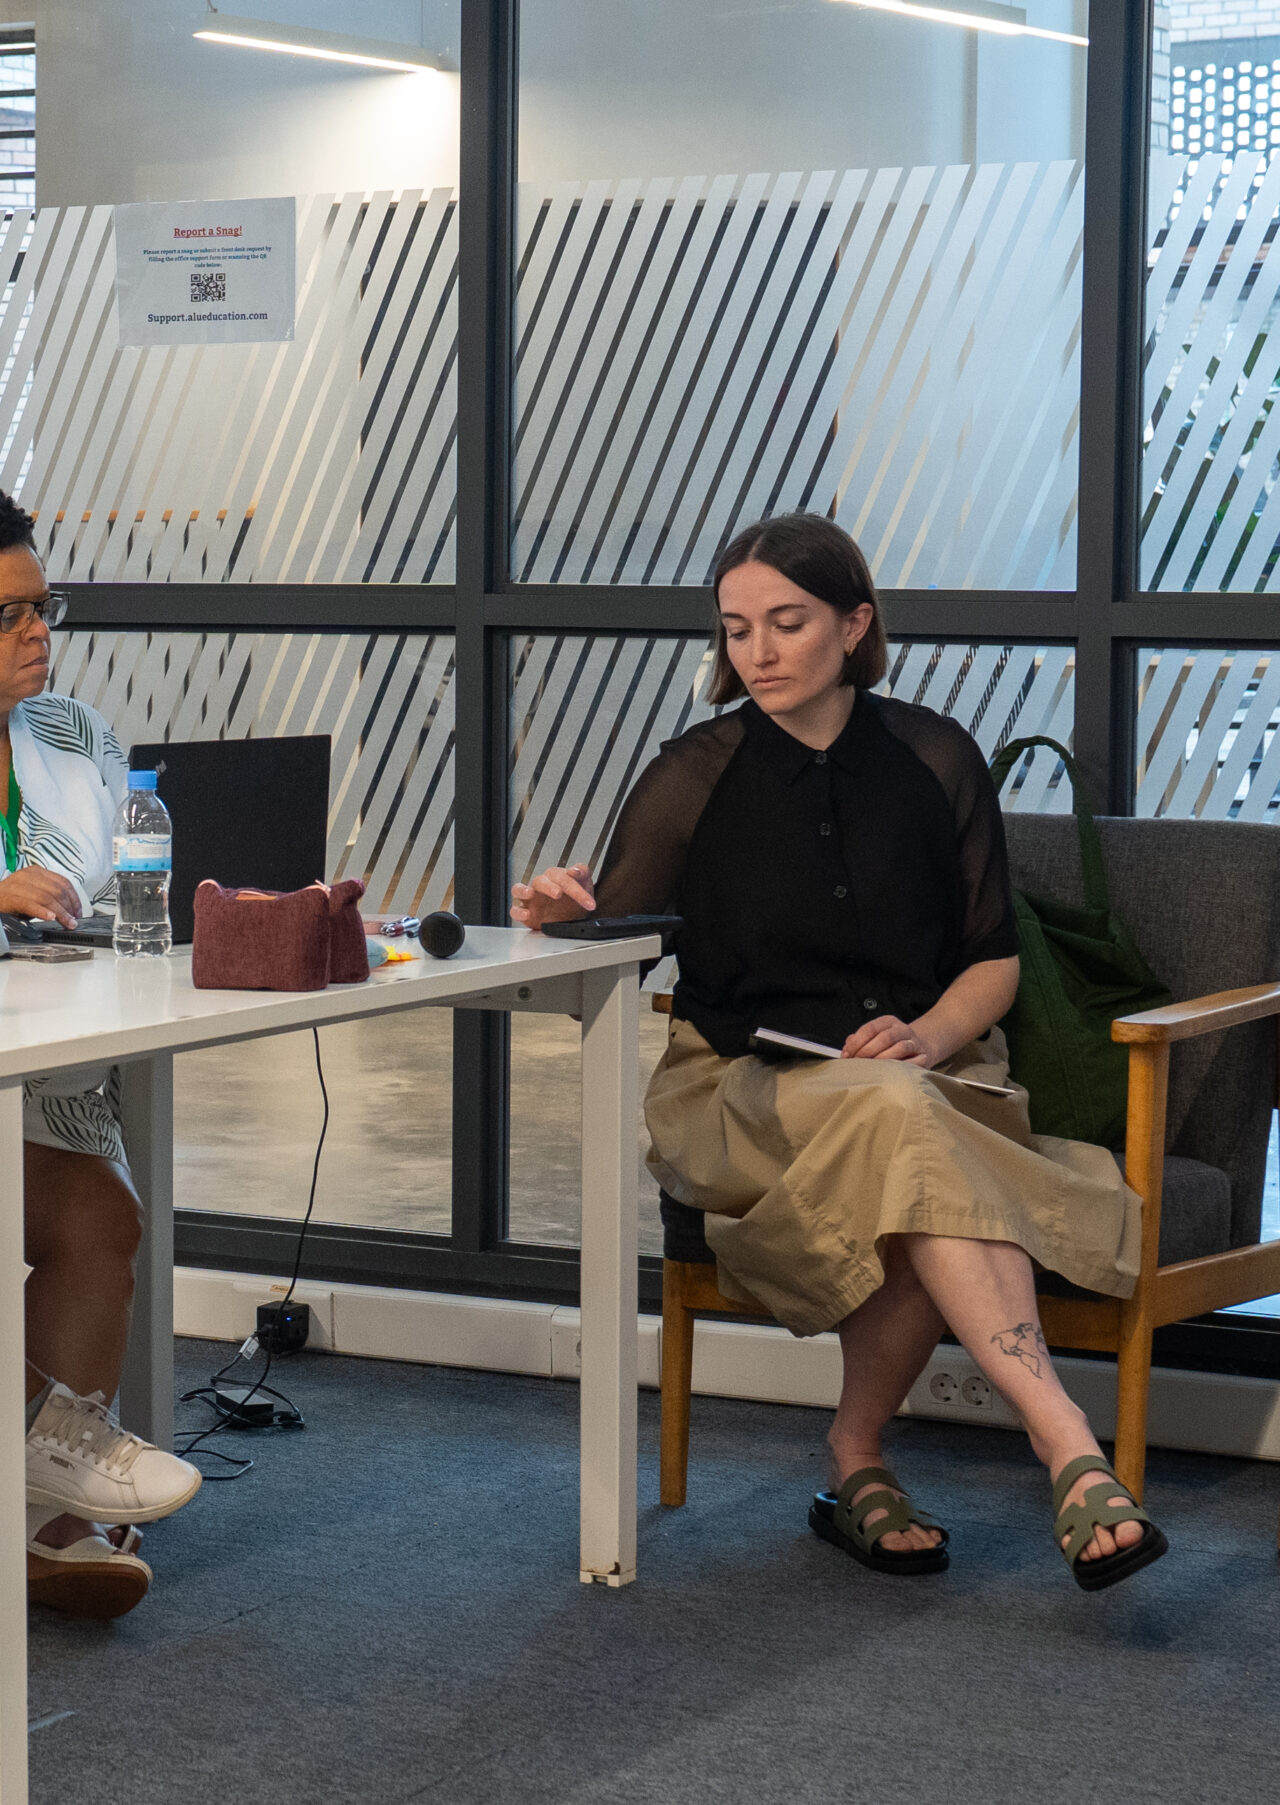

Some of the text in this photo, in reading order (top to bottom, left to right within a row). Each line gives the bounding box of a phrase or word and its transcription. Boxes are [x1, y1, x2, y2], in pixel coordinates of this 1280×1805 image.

[173, 225, 242, 238] Report a Snag!
[147, 311, 268, 325] Support.alueducation.com
